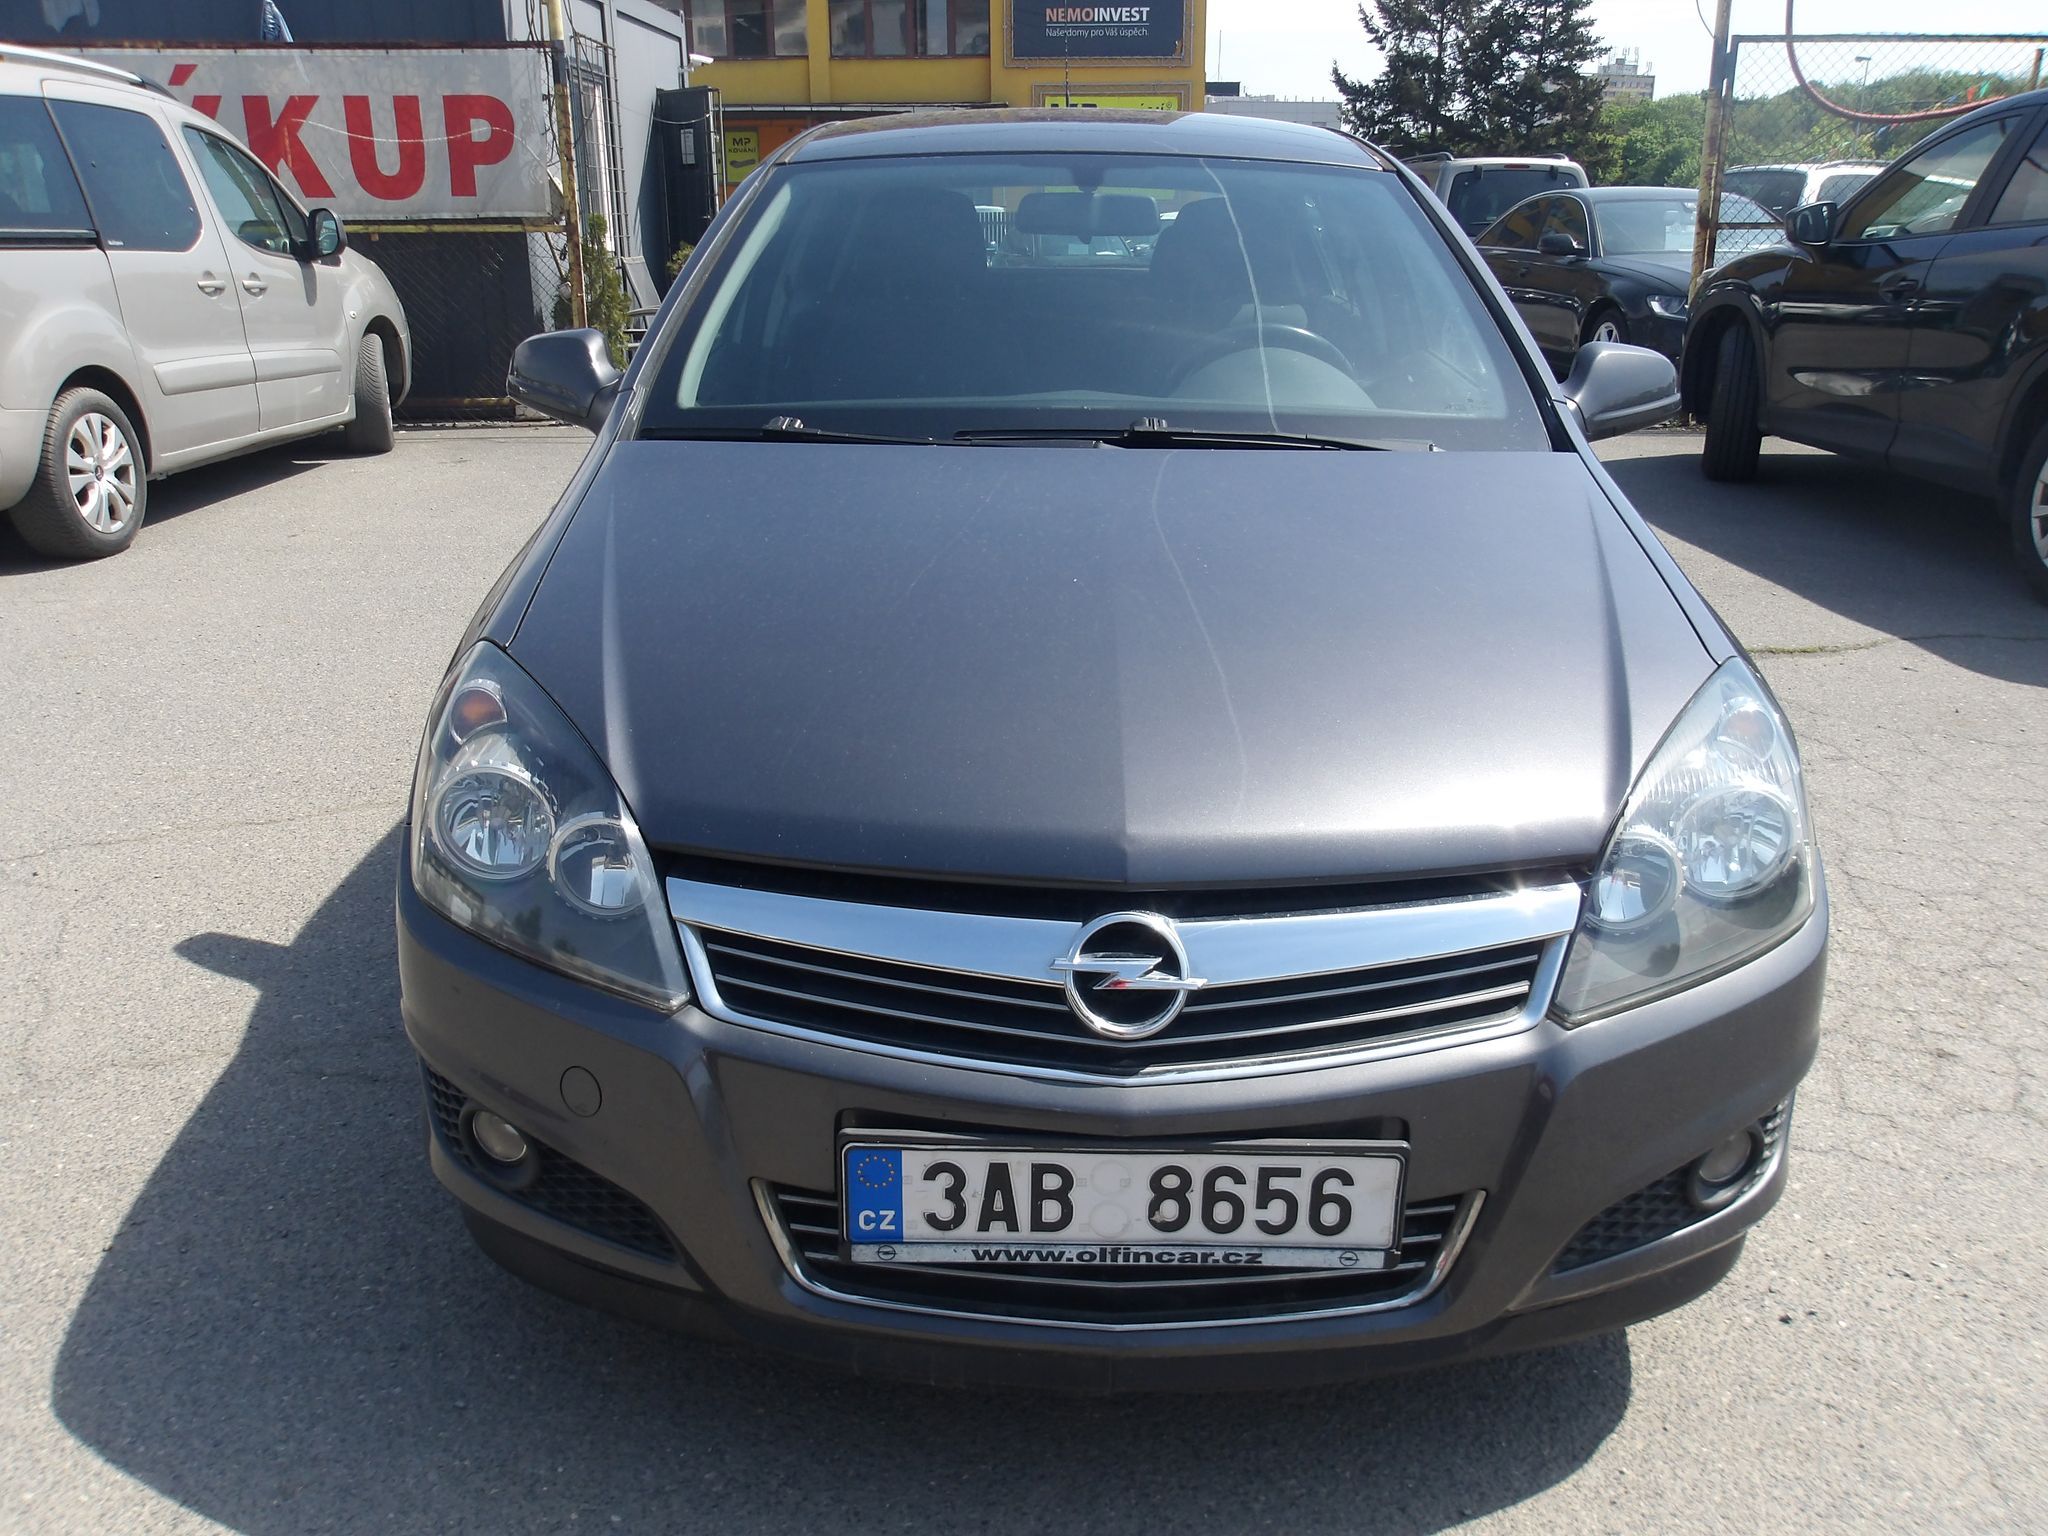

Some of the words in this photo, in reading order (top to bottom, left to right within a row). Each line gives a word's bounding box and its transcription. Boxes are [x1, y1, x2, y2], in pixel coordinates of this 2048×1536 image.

[1045, 7, 1150, 22] NEMOINVEST
[1066, 28, 1089, 38] domy
[1090, 29, 1104, 38] pro
[1105, 26, 1118, 37] Váš
[168, 64, 515, 201] KUP
[732, 137, 752, 147] MP
[922, 1160, 1075, 1233] 3AB
[1148, 1164, 1355, 1236] 8656
[858, 1209, 896, 1230] CZ
[971, 1247, 1263, 1264] www.olfincar.cz
